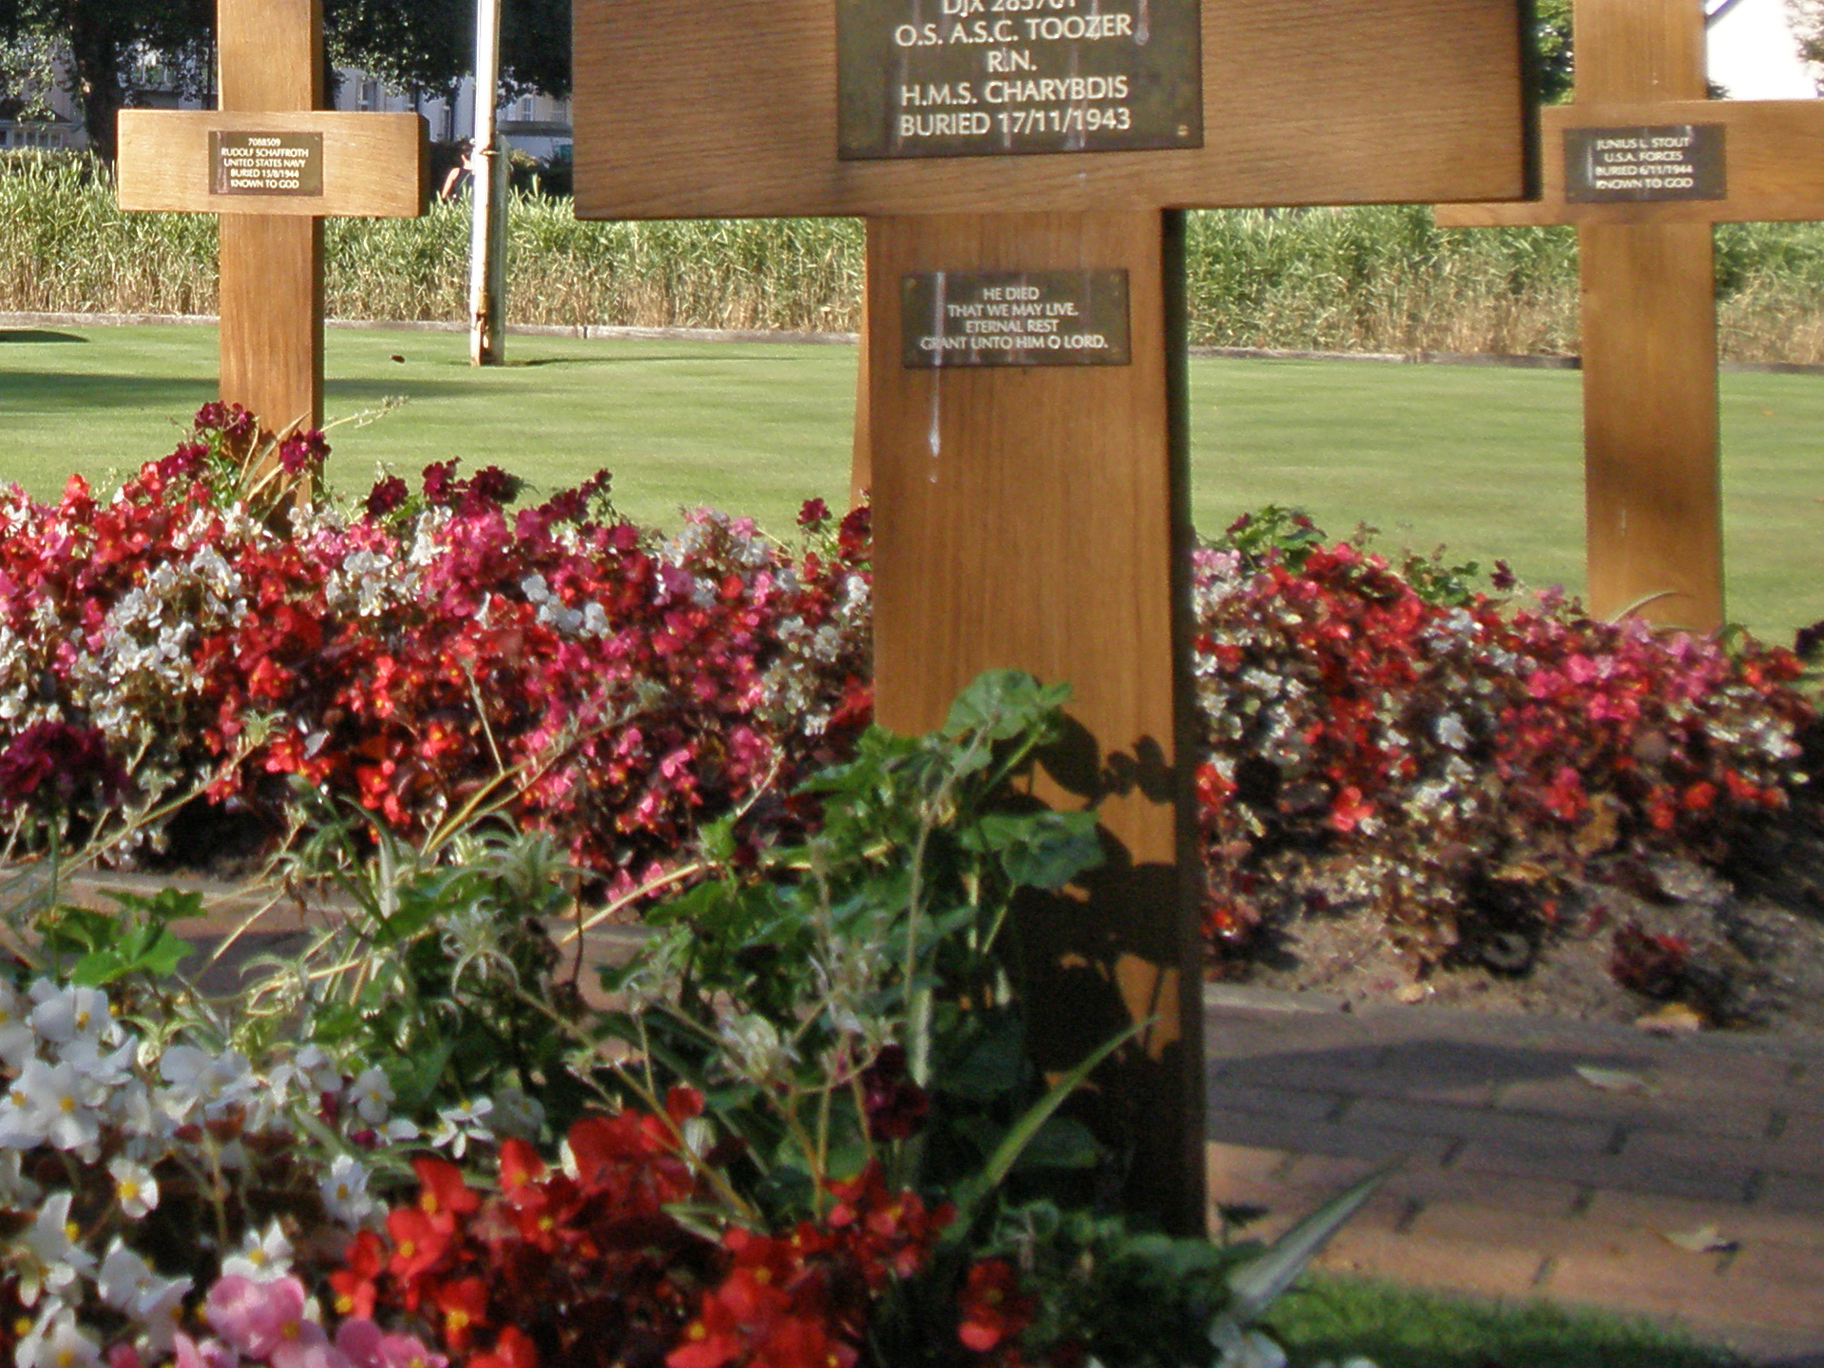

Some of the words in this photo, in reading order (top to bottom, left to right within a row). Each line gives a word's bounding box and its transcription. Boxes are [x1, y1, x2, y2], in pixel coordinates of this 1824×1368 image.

[895, 24, 944, 47] O.S.
[950, 22, 1018, 44] A.S.C.
[1026, 15, 1132, 40] TOOZER
[987, 50, 1037, 72] R.N.
[902, 83, 977, 106] H.M.S.
[985, 76, 1128, 104] CHARYBDIS
[900, 111, 990, 136] BURIED
[998, 108, 1130, 133] 17/11/1943
[1596, 139, 1637, 150] JUNIUS
[1652, 138, 1689, 147] STOUT
[221, 149, 254, 157] RUDOLF
[1640, 151, 1683, 162] FORCES
[224, 159, 254, 167] UNITED
[256, 159, 282, 167] STATES
[284, 160, 306, 168] NAVY
[231, 169, 260, 177] BURIED
[1595, 166, 1637, 176] BURIED
[231, 179, 263, 188] KNOWN
[266, 180, 277, 188] TO
[279, 180, 299, 188] GOD
[1596, 180, 1642, 189] KNOWN
[1645, 179, 1662, 188] TO
[1665, 178, 1693, 187] GOD
[983, 288, 1002, 301] HE
[1006, 287, 1040, 300] DIED
[948, 305, 984, 317] THAT
[988, 305, 1009, 316] WE
[1012, 304, 1043, 316] MAY
[1046, 303, 1079, 315] LIVE.
[966, 320, 1023, 333] ETERNAL
[1027, 319, 1059, 332] REST
[921, 336, 967, 350] GRANT
[971, 336, 1012, 349] UNTO
[1016, 336, 1044, 348] HIM
[1064, 336, 1108, 348] LORD.
